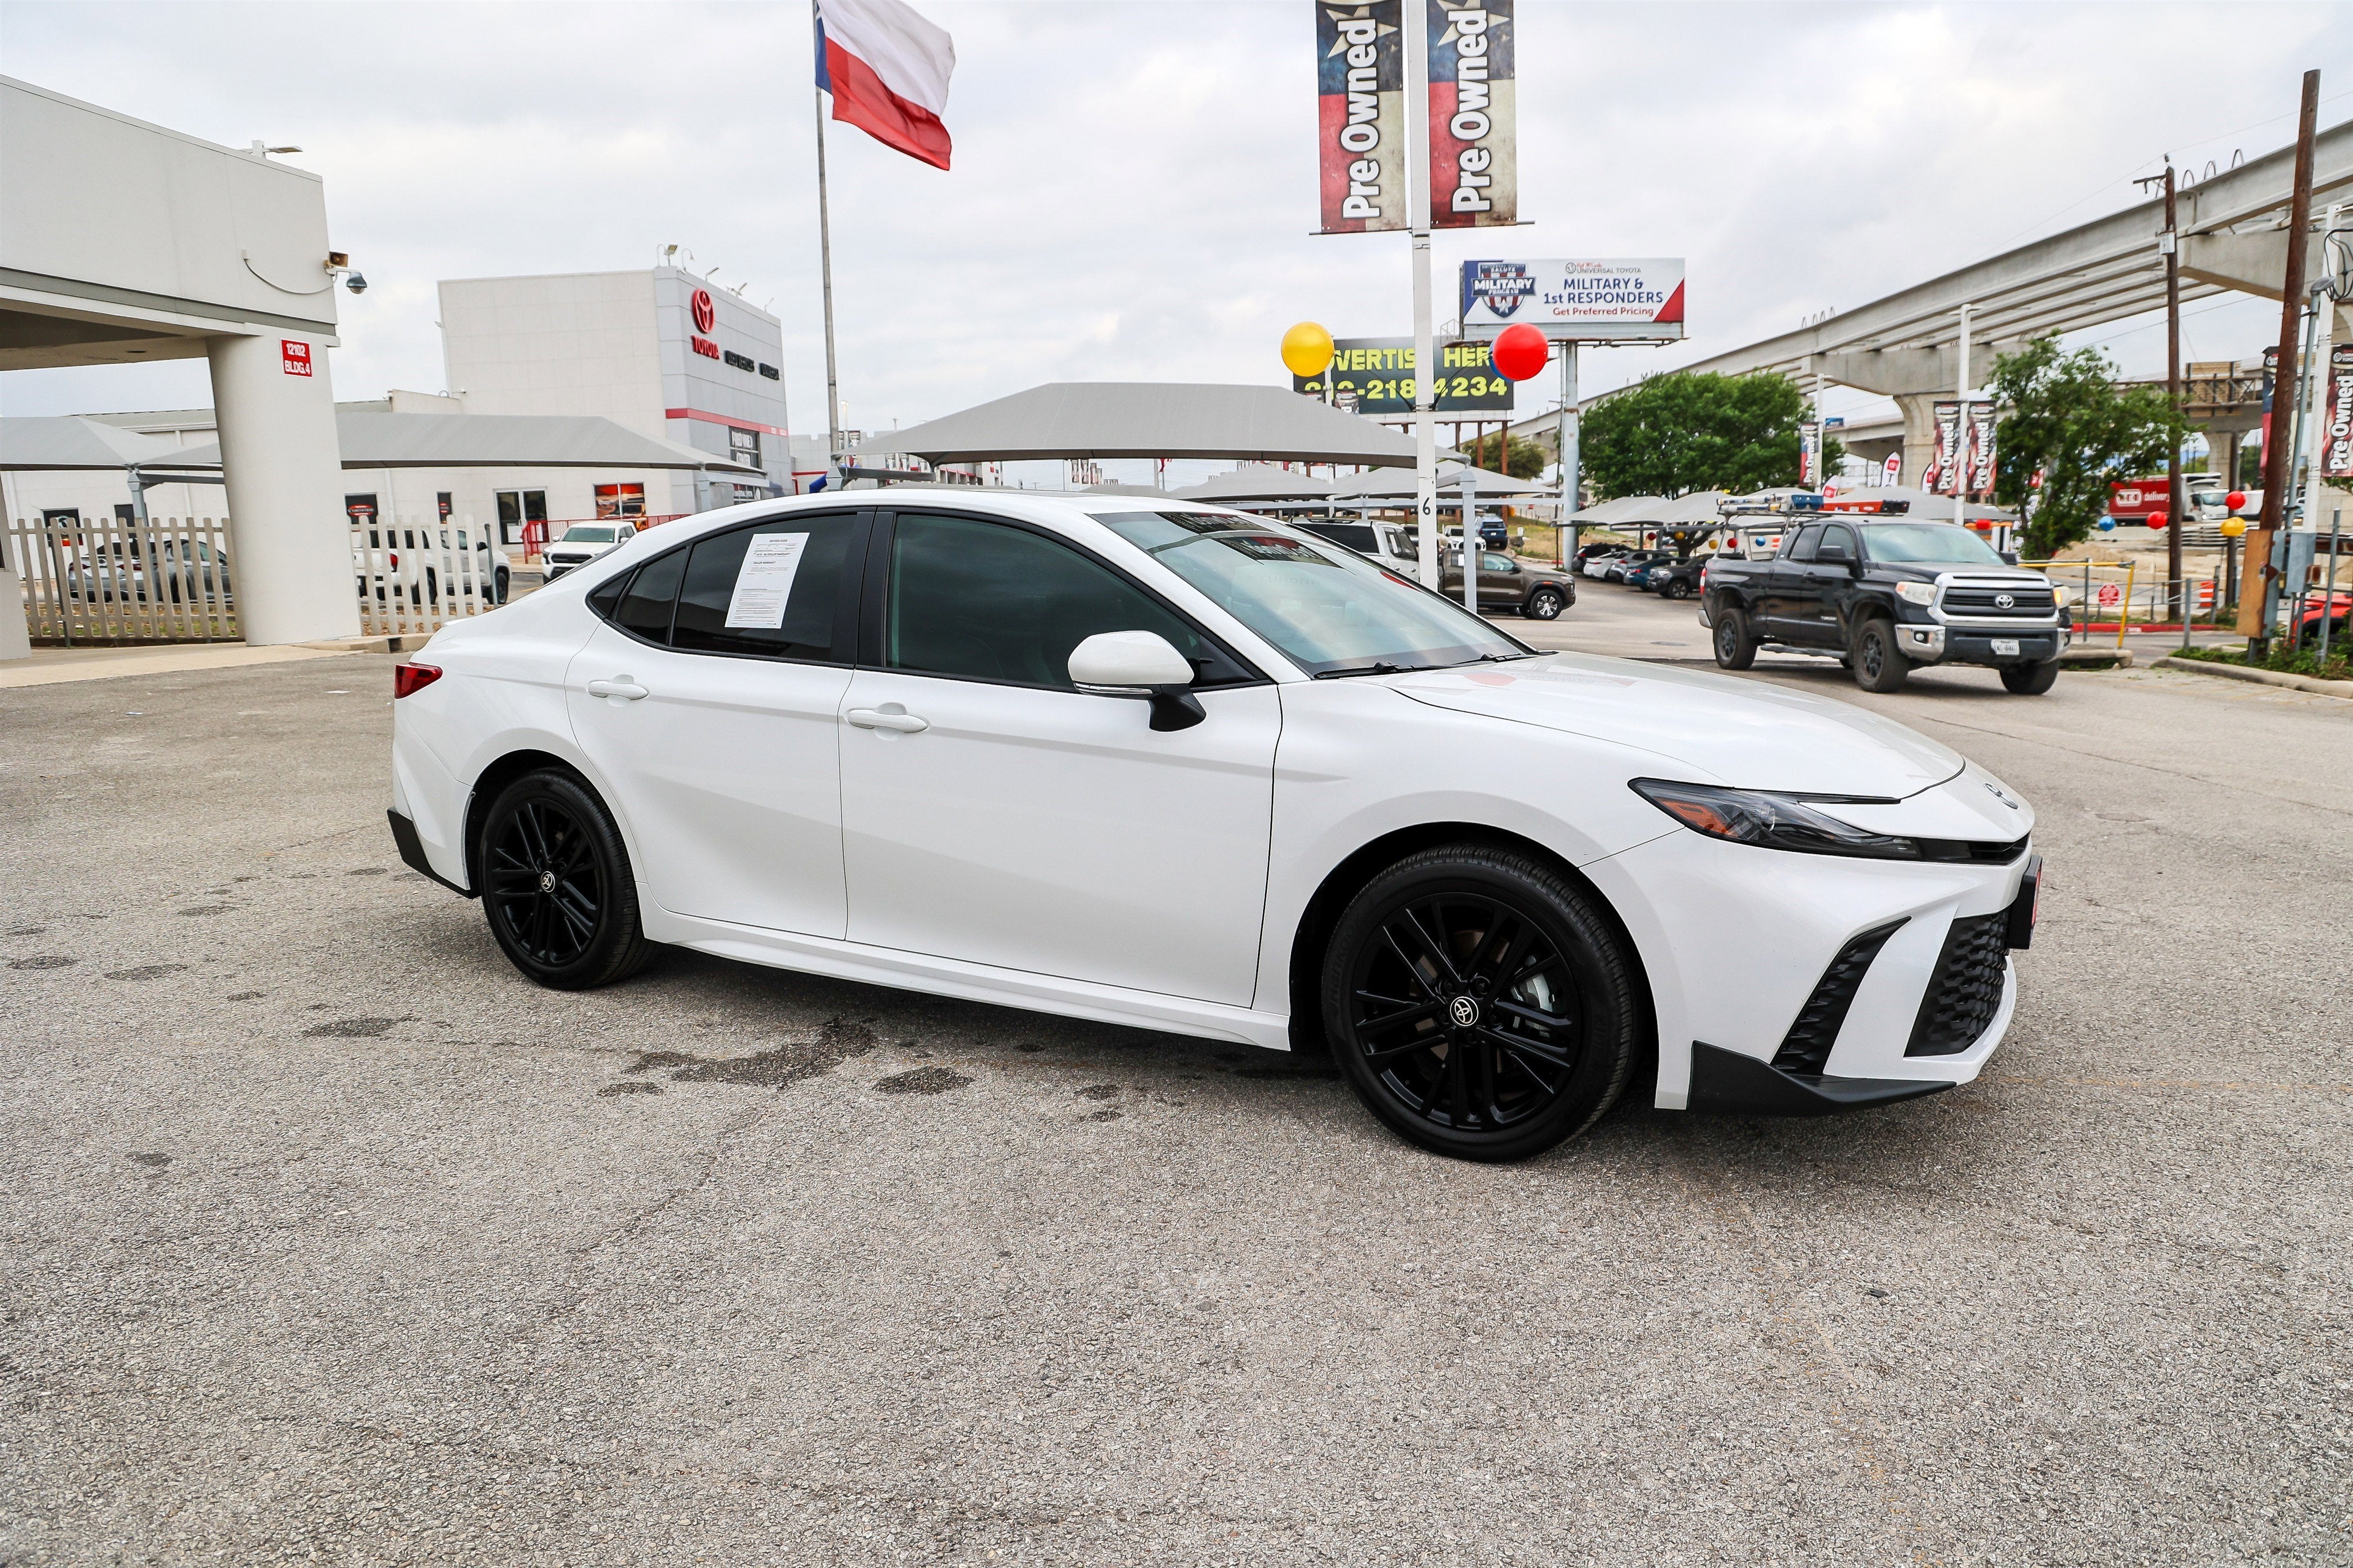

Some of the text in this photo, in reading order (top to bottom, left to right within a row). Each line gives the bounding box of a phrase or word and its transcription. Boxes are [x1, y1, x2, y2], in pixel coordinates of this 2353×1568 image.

[1338, 19, 1380, 218] Pre Owned
[1448, 9, 1491, 213] Pre Owned
[1474, 277, 1534, 290] MILITARY
[1564, 278, 1644, 289] MILITARY &
[1544, 291, 1664, 304] 1st RESPONDERS
[1553, 306, 1654, 317] Get Preferred Pricing
[691, 335, 720, 360] TOYOTA
[1444, 347, 1492, 368] HER
[284, 360, 306, 374] BLDG
[2330, 376, 2353, 438] Owned
[1940, 422, 1954, 467] Owned
[1974, 422, 1989, 466] Owned
[2329, 440, 2350, 470] Pre
[1938, 468, 1953, 489] Pre
[1973, 468, 1988, 489] Pre
[1422, 496, 1431, 516] 6
